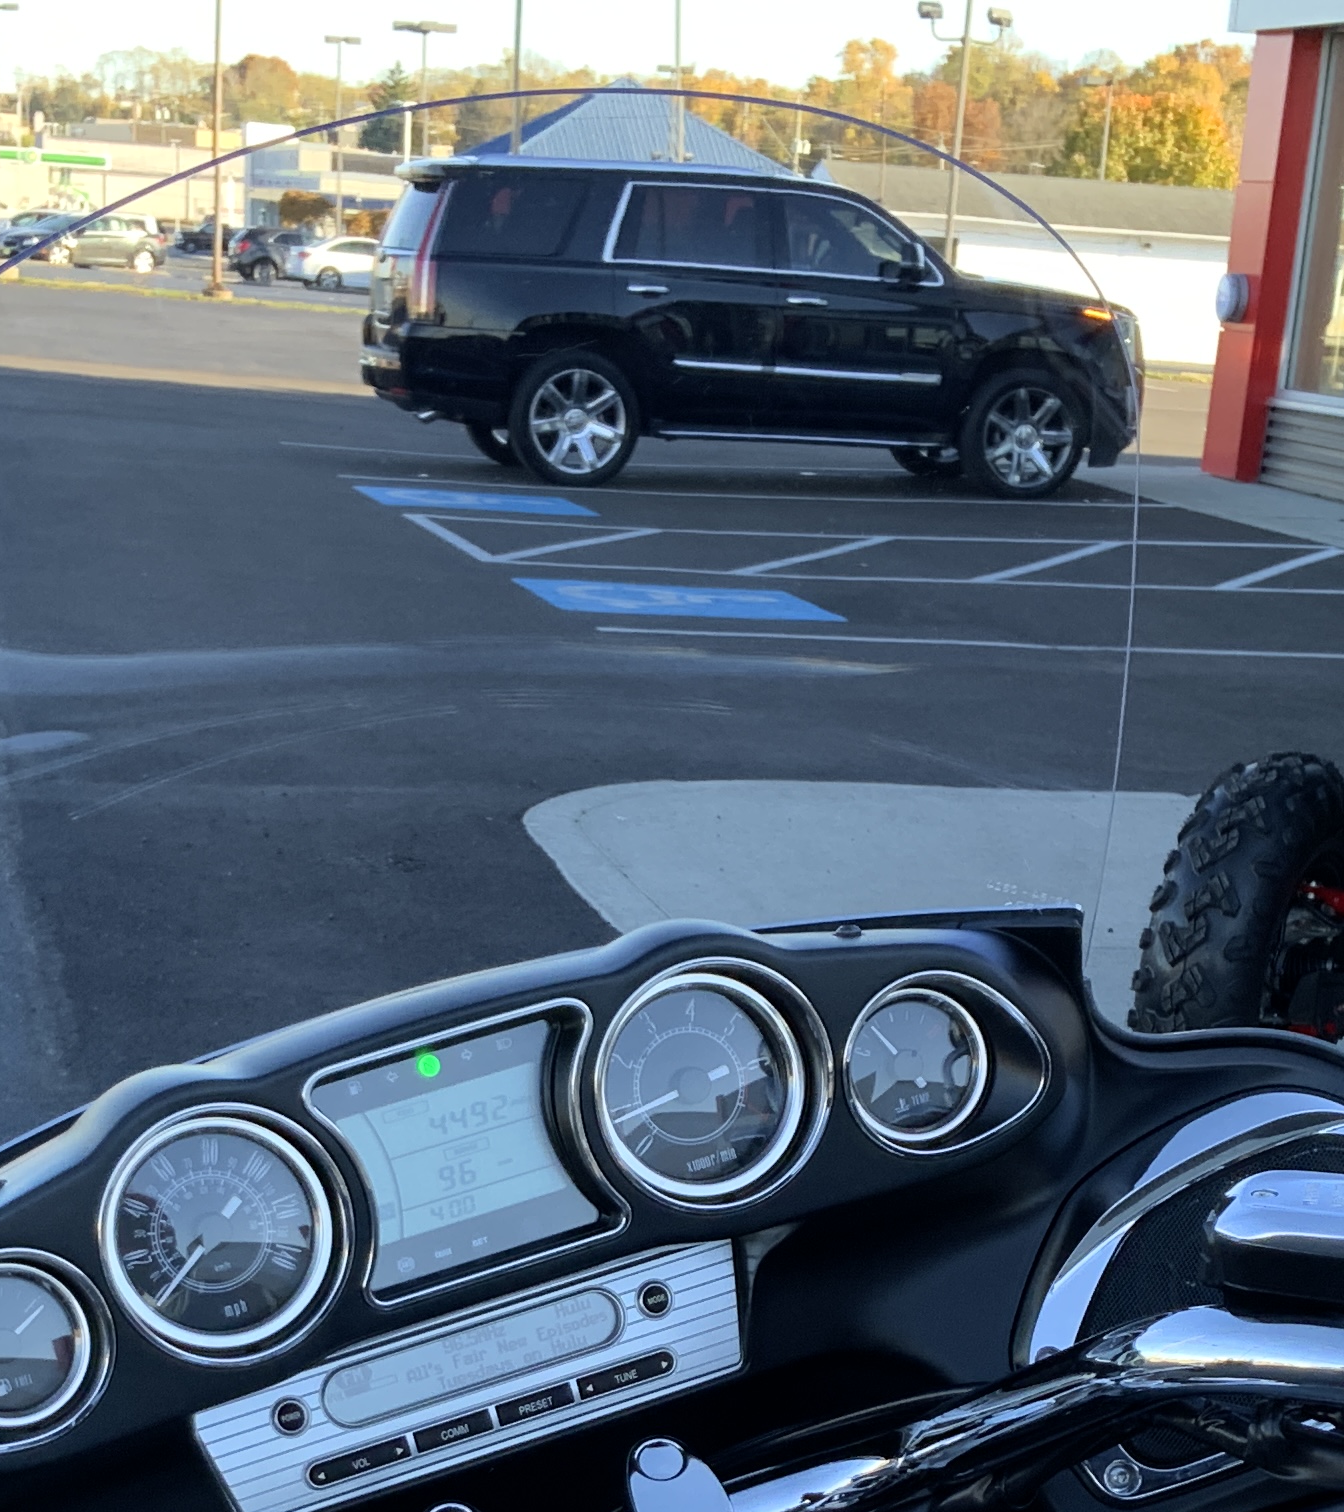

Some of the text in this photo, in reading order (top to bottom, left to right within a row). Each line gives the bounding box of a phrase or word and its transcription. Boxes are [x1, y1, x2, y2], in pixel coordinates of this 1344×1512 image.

[201, 1138, 219, 1165] 80
[242, 1150, 272, 1182] 100
[224, 1298, 248, 1318] mph
[556, 1299, 592, 1319] Hulu
[406, 1312, 607, 1384] All's Fair New Episodes
[438, 1334, 589, 1390] Tuesdays on Hulu
[613, 1367, 639, 1385] TUNE
[518, 1396, 554, 1415] PRESET
[440, 1423, 470, 1441] COMM
[351, 1455, 371, 1470] VOL
